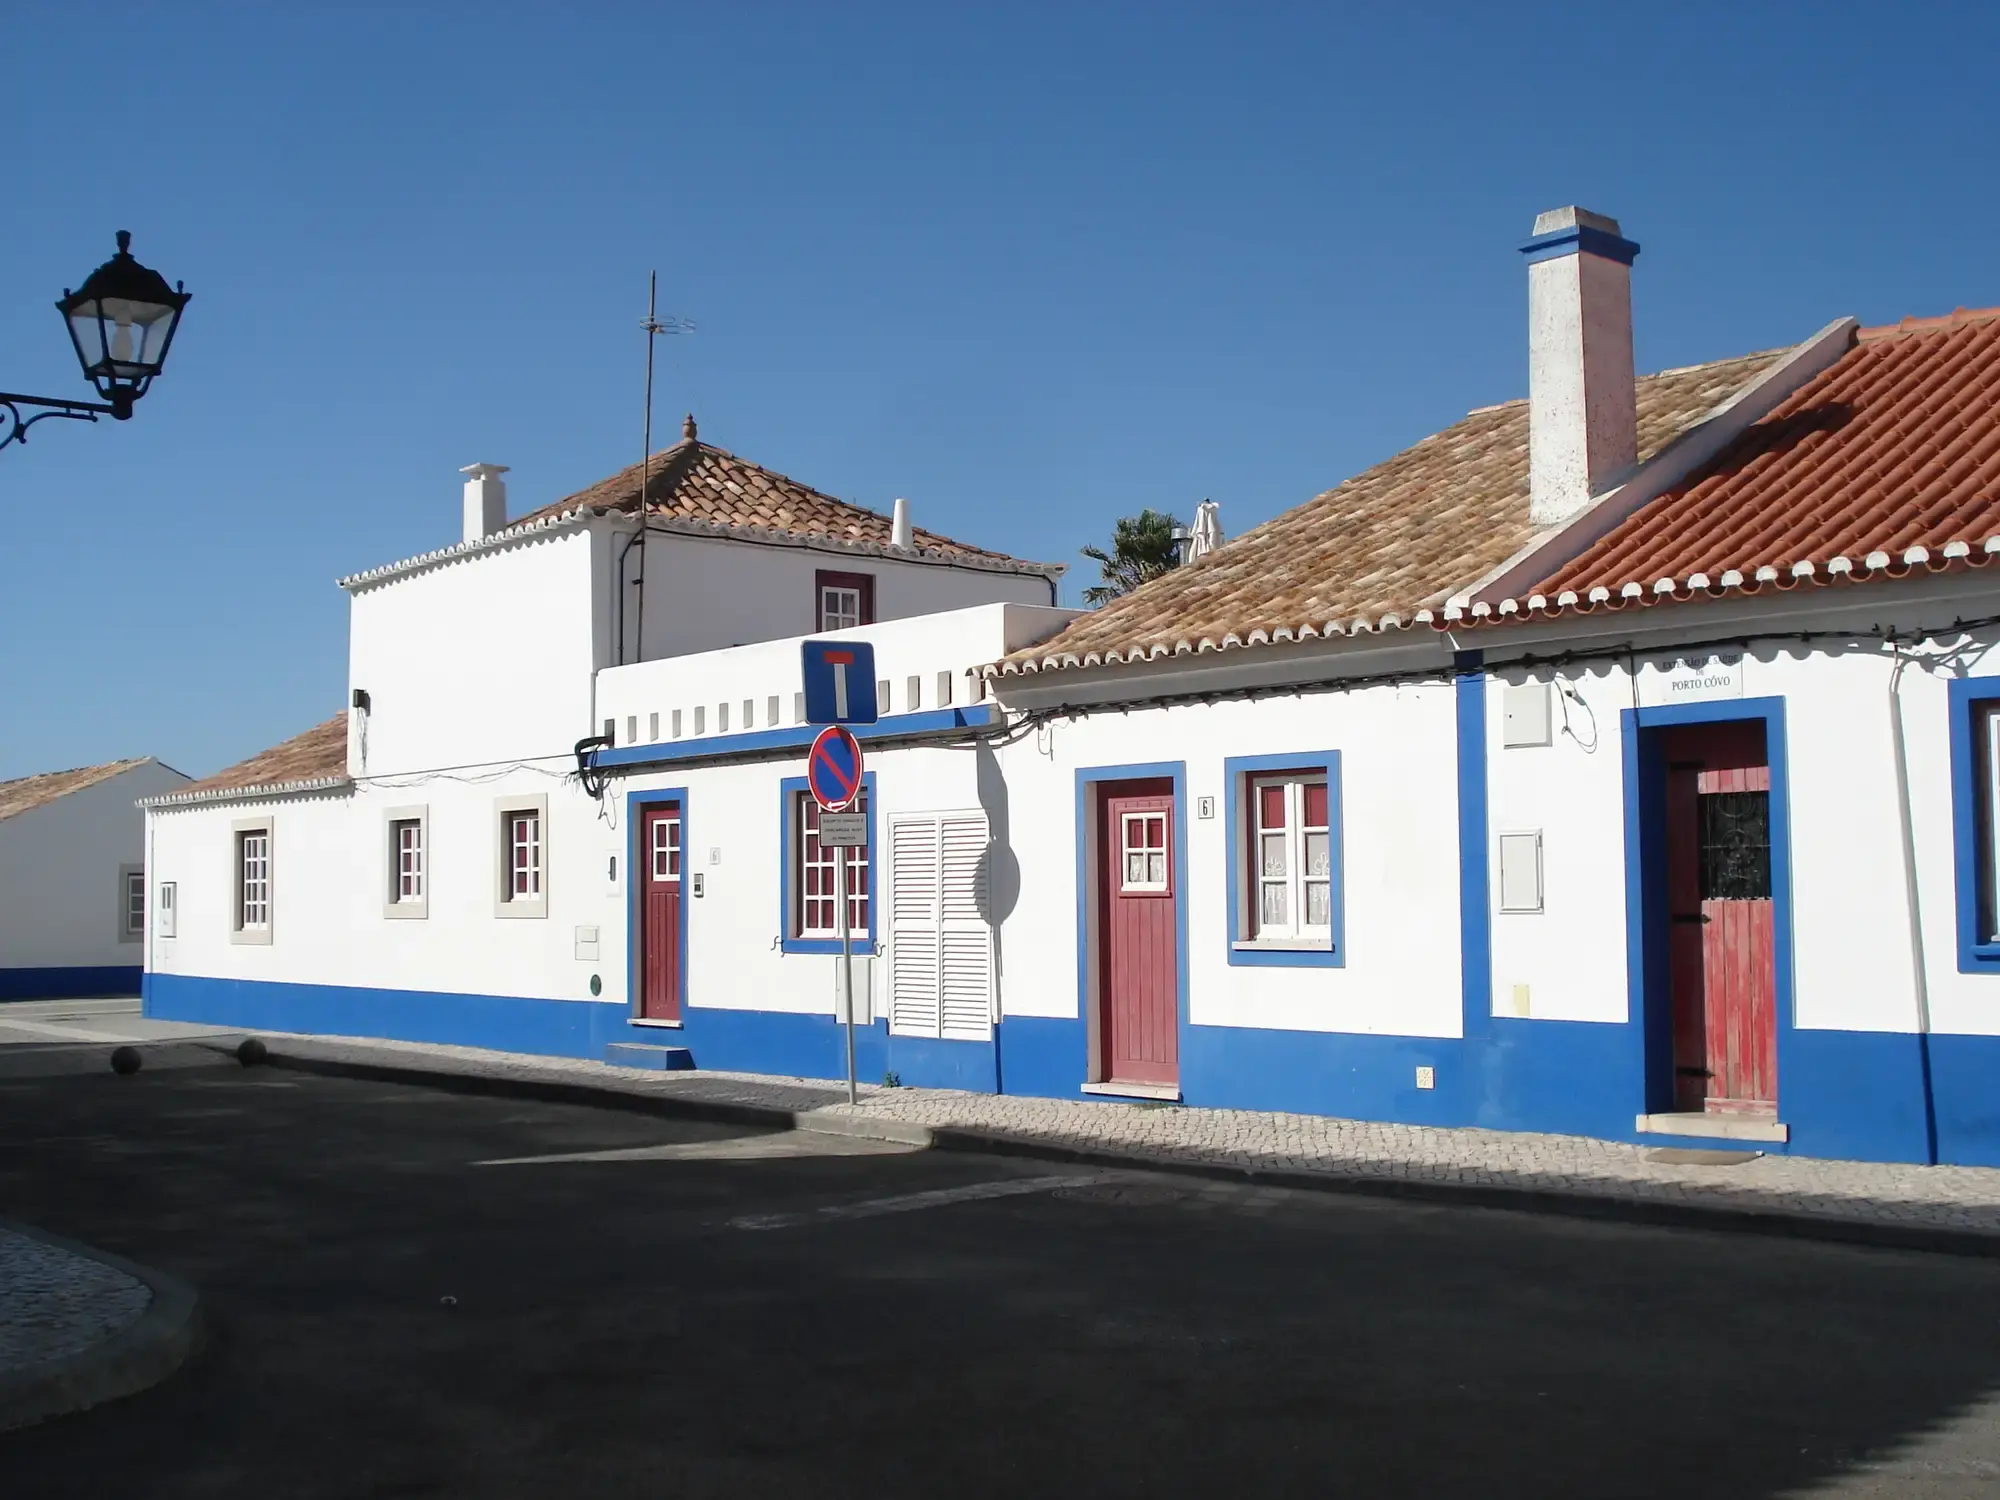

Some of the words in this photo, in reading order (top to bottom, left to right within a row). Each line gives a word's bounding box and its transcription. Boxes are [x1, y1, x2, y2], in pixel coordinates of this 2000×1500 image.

[1672, 679, 1702, 691] PORTO
[1704, 675, 1731, 688] CÓVO
[1203, 800, 1208, 816] 6
